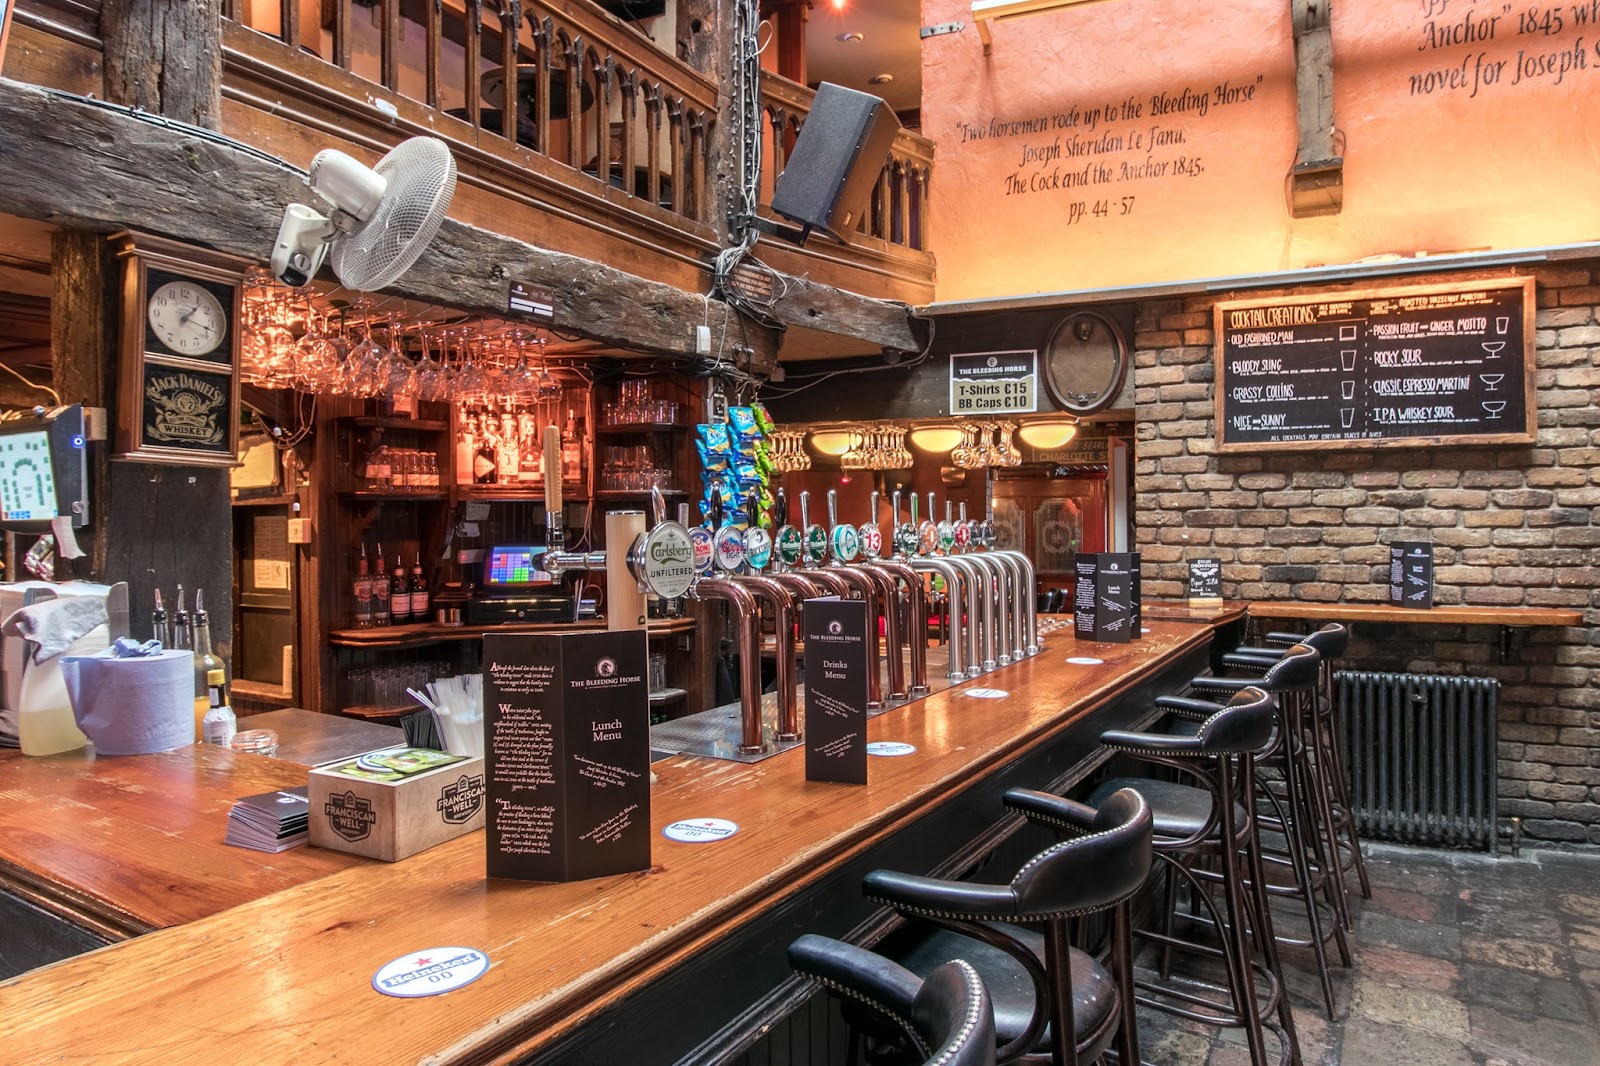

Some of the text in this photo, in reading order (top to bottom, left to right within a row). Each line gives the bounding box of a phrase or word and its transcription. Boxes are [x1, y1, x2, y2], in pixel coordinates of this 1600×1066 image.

[1517, 6, 1563, 36] 1845
[1409, 54, 1472, 96] novel
[1469, 52, 1507, 98] for
[1511, 37, 1587, 86] Joseph
[988, 115, 1048, 138] horsemen
[1052, 104, 1080, 128] rode
[1084, 108, 1101, 132] up
[1104, 104, 1118, 123] to
[1120, 96, 1142, 121] the
[1150, 89, 1209, 117] Bleeding
[1212, 75, 1263, 106] Horse"
[1019, 125, 1186, 168] Joseph Sheridan Le Fanu,
[1004, 157, 1205, 196] The Cock and the Anchor 1845.
[1066, 200, 1088, 226] pp.
[1092, 200, 1108, 218] 44
[1120, 196, 1136, 216] 57
[169, 290, 176, 300] 11
[180, 288, 190, 298] 12
[157, 296, 168, 306] 10
[153, 309, 160, 318] 9
[1374, 324, 1400, 336] PASSION
[1400, 322, 1420, 334] FRUIT
[1457, 317, 1487, 331] MOJITO
[1231, 334, 1242, 345] OLD
[1244, 331, 1276, 344] FASHIONED
[1277, 330, 1294, 342] MAN
[1374, 350, 1400, 365] ROCKY
[1401, 348, 1422, 364] SOUR
[972, 366, 1004, 375] BLEEDING
[1004, 364, 1027, 372] HORSE
[1232, 361, 1260, 374] BLOODY
[151, 374, 221, 401] JACK DANIEL'S
[960, 382, 1027, 396] T-Shirts €15
[1233, 386, 1262, 400] GRASSY
[1266, 382, 1294, 398] COLLINS
[1373, 375, 1470, 394] CLASSIC ESPRESSO MARTINI
[959, 395, 1027, 412] BB Caps €10
[1398, 406, 1432, 420] WHISKEY
[1433, 406, 1454, 418] SOUR
[1233, 414, 1252, 428] NICE
[1261, 414, 1286, 426] SUNNY
[164, 425, 208, 436] WHISKEY
[1040, 452, 1094, 461] CHARLOTTE
[866, 533, 880, 550] 13
[651, 542, 692, 562] Carlsberg
[651, 568, 692, 578] UNFILTERED
[823, 660, 848, 669] Drinks
[586, 678, 618, 686] BLEEDING
[824, 671, 846, 680] Menu
[592, 719, 622, 731] Lunch
[593, 731, 622, 741] Menu
[326, 805, 374, 822] FRANCISCAN
[386, 953, 478, 987] Heineken
